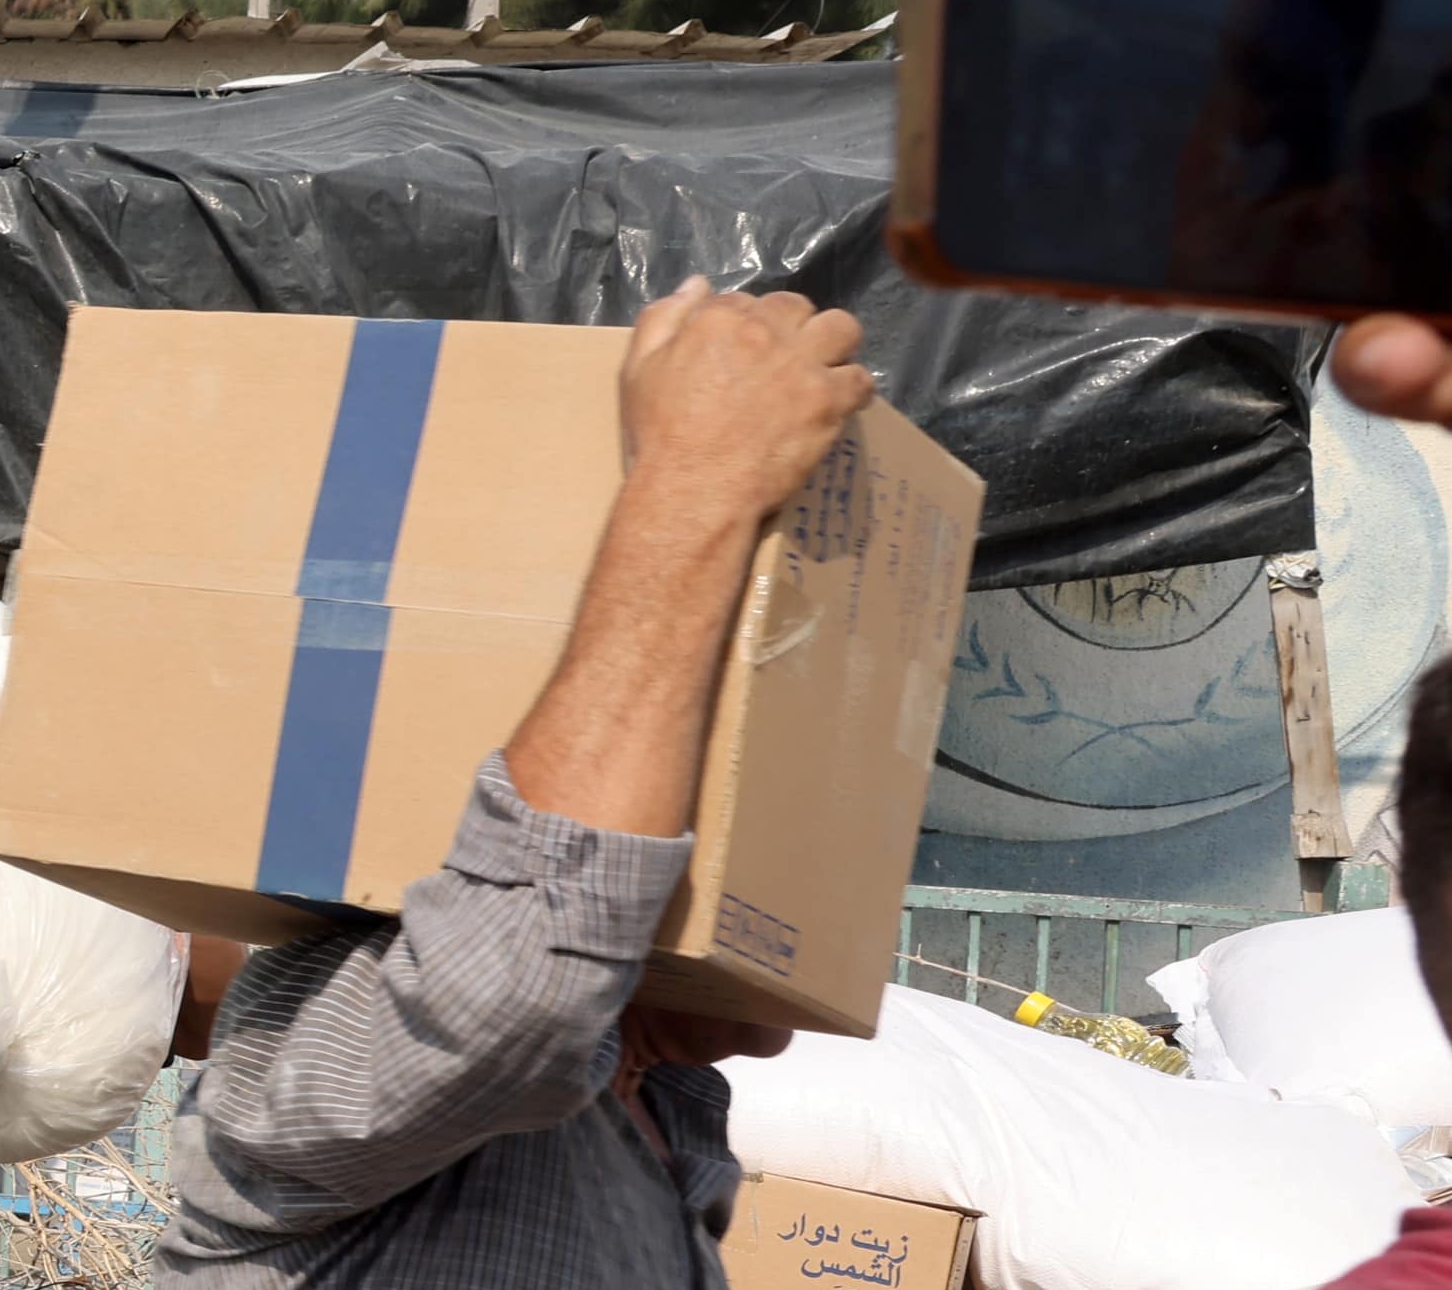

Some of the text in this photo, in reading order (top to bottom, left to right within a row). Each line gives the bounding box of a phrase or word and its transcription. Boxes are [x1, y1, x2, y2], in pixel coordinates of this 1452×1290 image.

[777, 1213, 909, 1264] زيت دوار
[800, 1258, 901, 1289] الشمس
